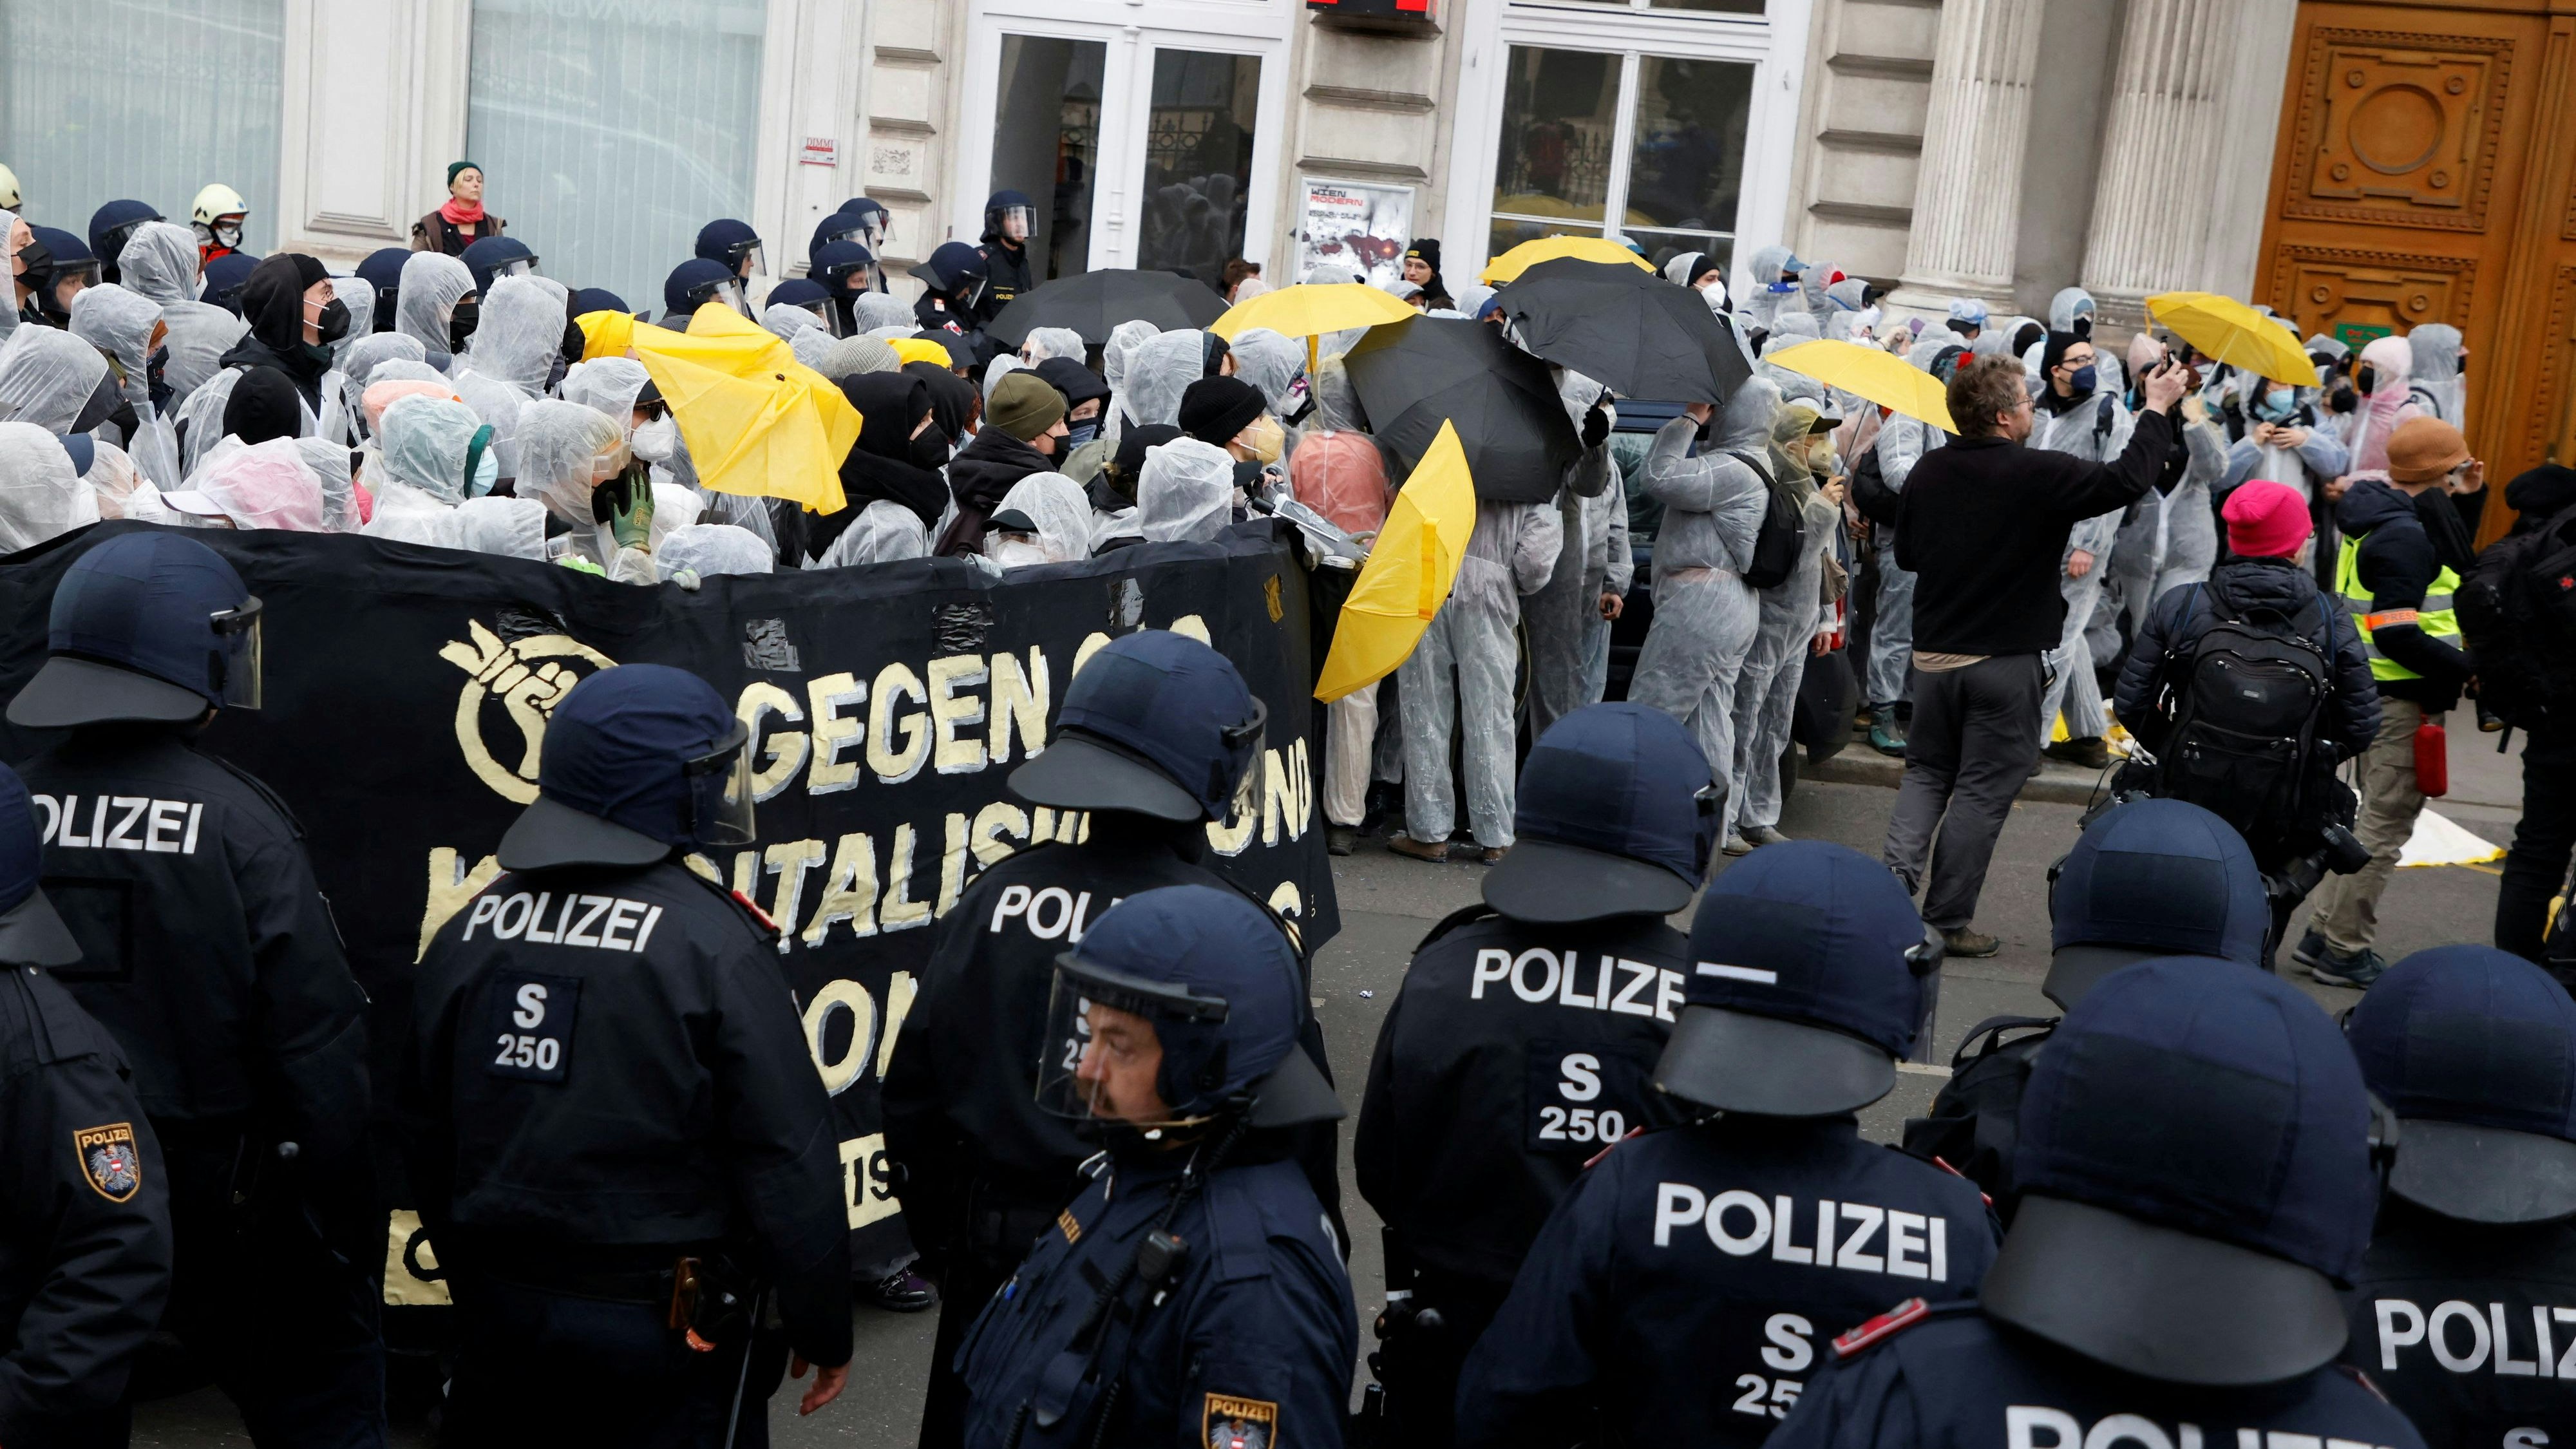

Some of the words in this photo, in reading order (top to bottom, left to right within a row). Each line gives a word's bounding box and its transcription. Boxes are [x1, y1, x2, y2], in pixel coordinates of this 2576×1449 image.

[1310, 196, 1364, 206] MODERN
[724, 645, 1050, 805] GEGEN
[32, 794, 204, 855] OLIZEI
[462, 891, 663, 953] POLIZEI
[513, 983, 547, 1029] S
[1471, 947, 1685, 1023] POLIZE
[495, 1033, 560, 1071] 250
[1558, 1053, 1602, 1102] S
[81, 1129, 130, 1148] POLIZEI
[1539, 1106, 1625, 1144] 250
[1654, 1182, 1947, 1282] POLIZEI
[1761, 1313, 1814, 1372] S
[1211, 1399, 1271, 1421] POLIZEI
[1732, 1374, 1803, 1420] 25
